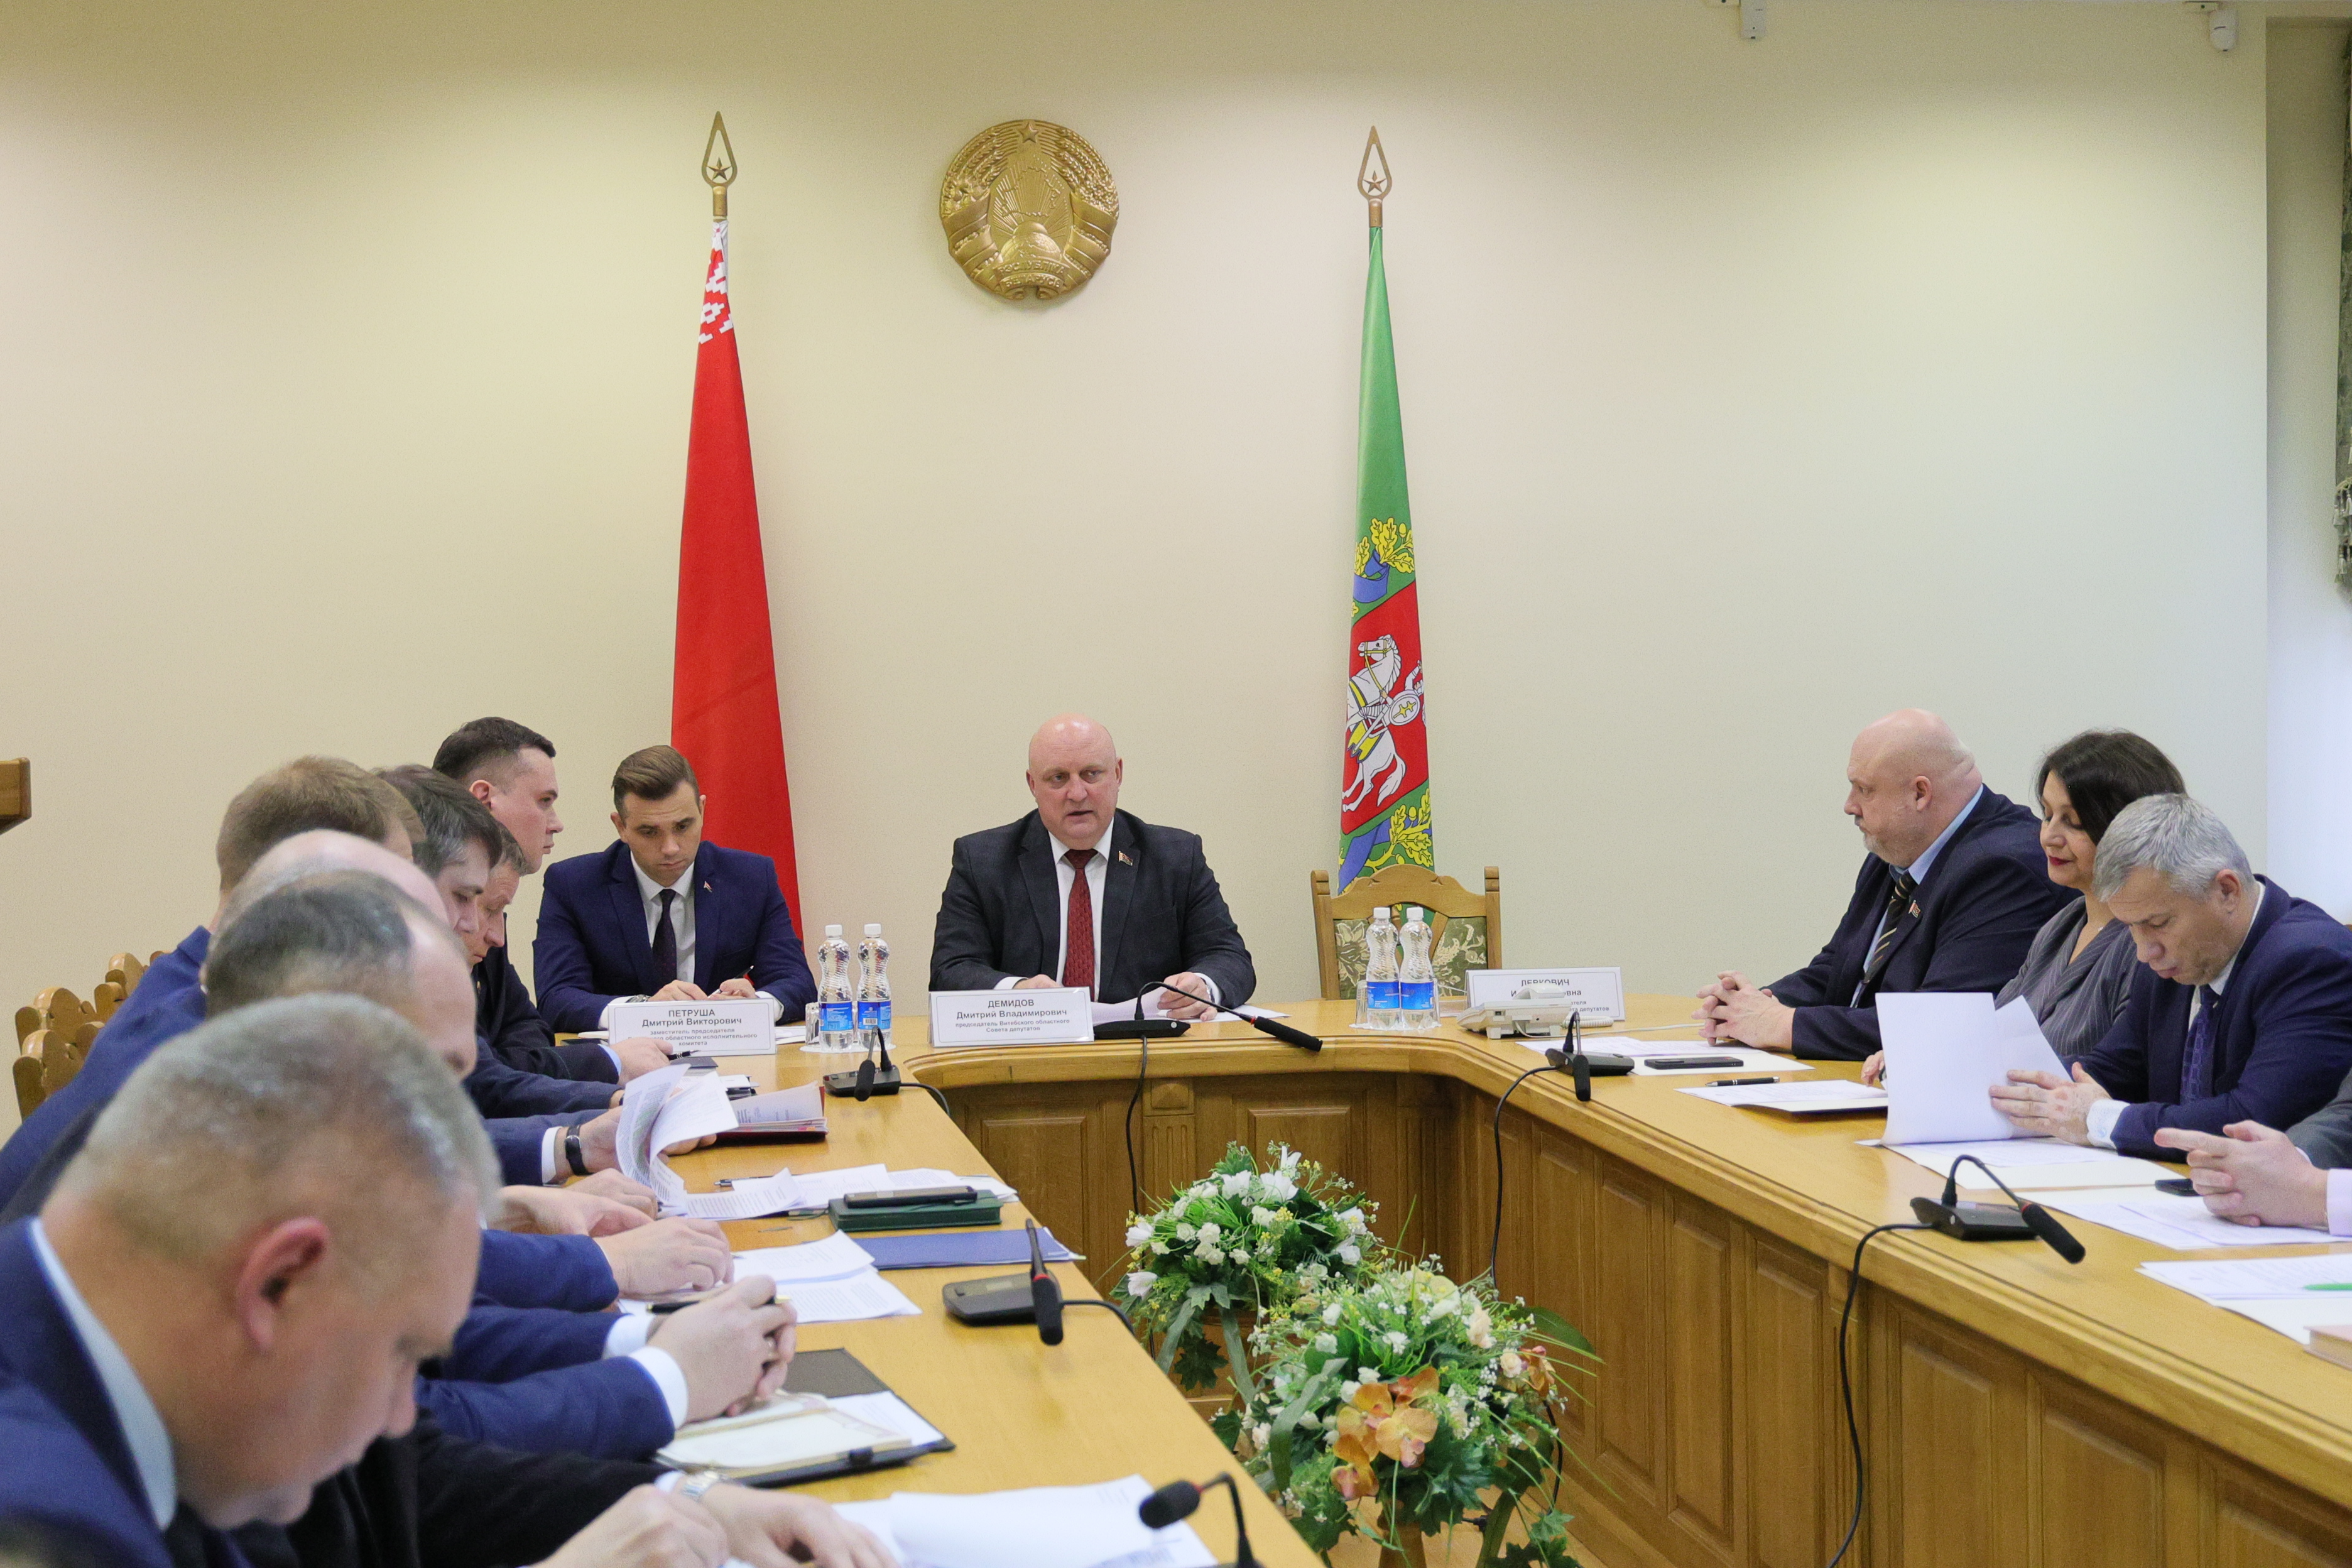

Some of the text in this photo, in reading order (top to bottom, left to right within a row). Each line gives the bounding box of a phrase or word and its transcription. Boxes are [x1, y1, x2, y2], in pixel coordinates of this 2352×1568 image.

[988, 999, 1035, 1008] ДЕМИДОВ
[668, 1009, 716, 1017] ПЕТРУША
[956, 1010, 1067, 1020] Дмитрий Владимирович
[642, 1017, 742, 1027] Дмитрий Викторович
